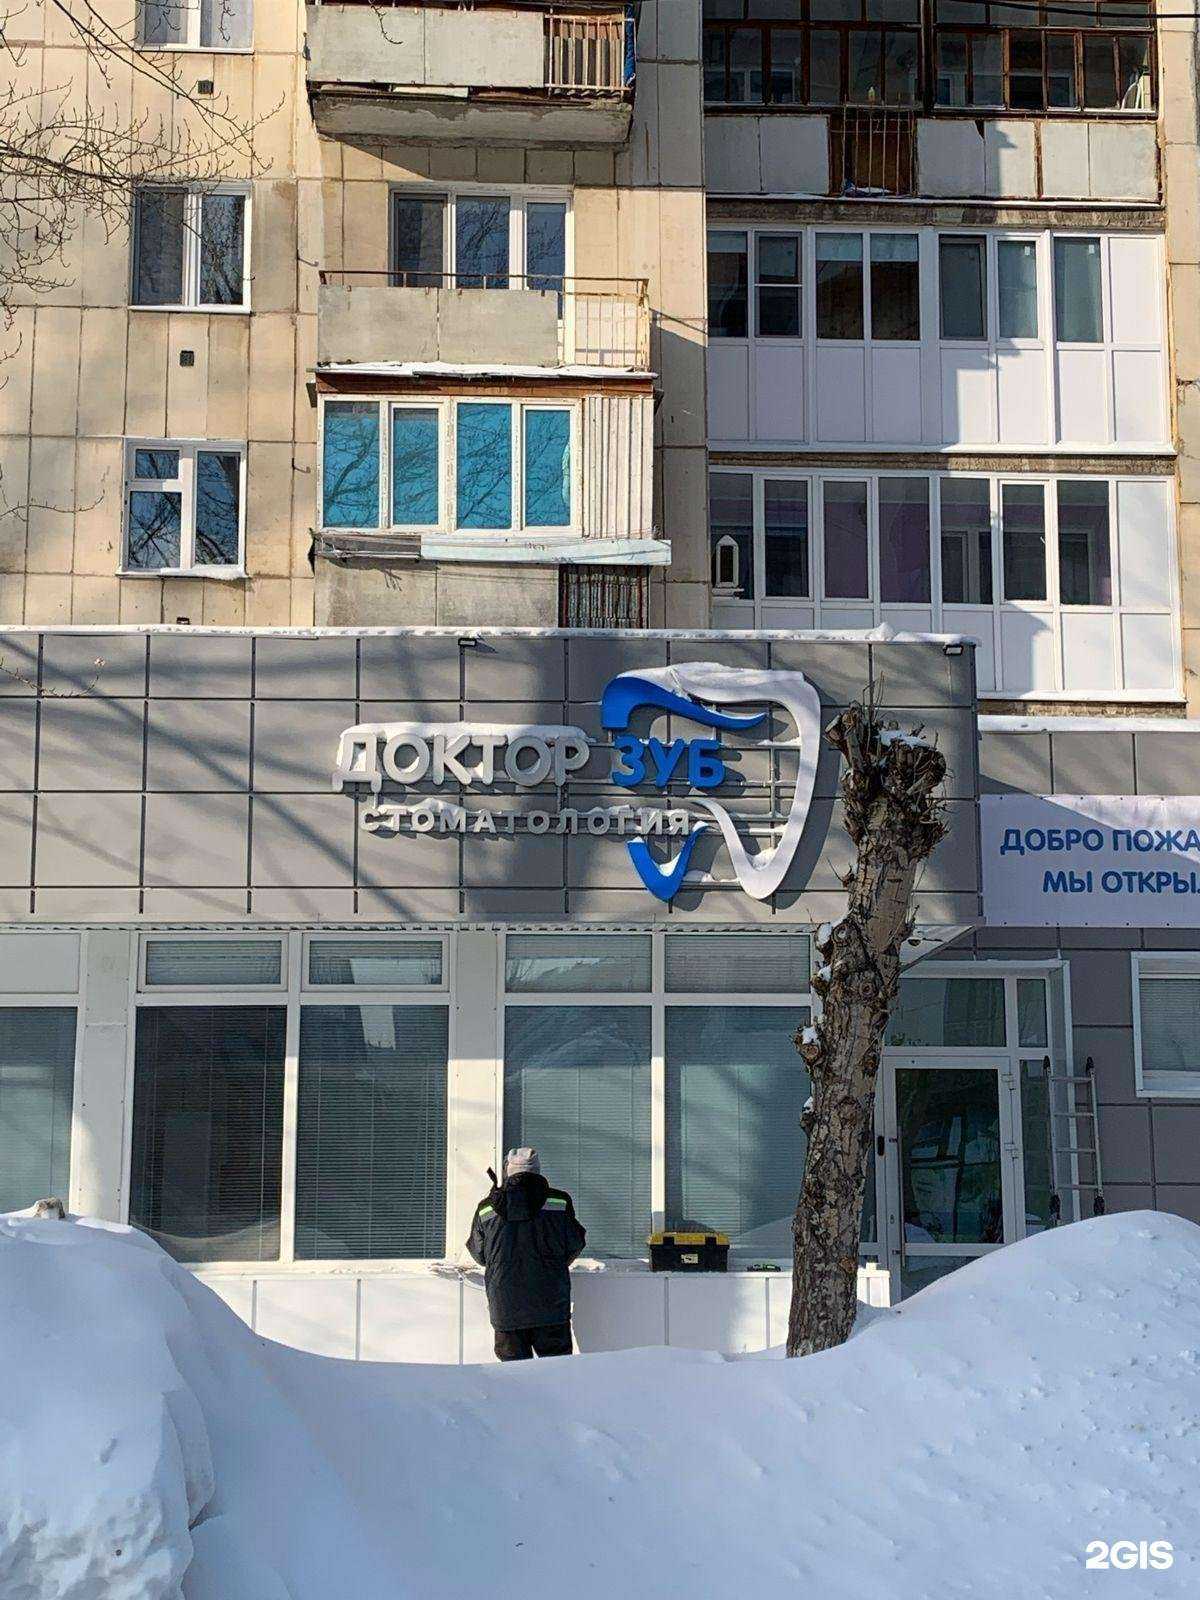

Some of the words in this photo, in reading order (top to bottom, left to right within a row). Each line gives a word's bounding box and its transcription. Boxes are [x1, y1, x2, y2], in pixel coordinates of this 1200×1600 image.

[333, 732, 591, 793] ДОКТОР
[611, 735, 727, 788] ЗУБ
[359, 807, 691, 835] СТОМАТОЛОГИЯ
[1000, 828, 1105, 856] ДОБРО
[1112, 828, 1200, 852] ПОЖА
[1042, 870, 1093, 893] МЫ
[1101, 870, 1200, 894] ОТКРЫ
